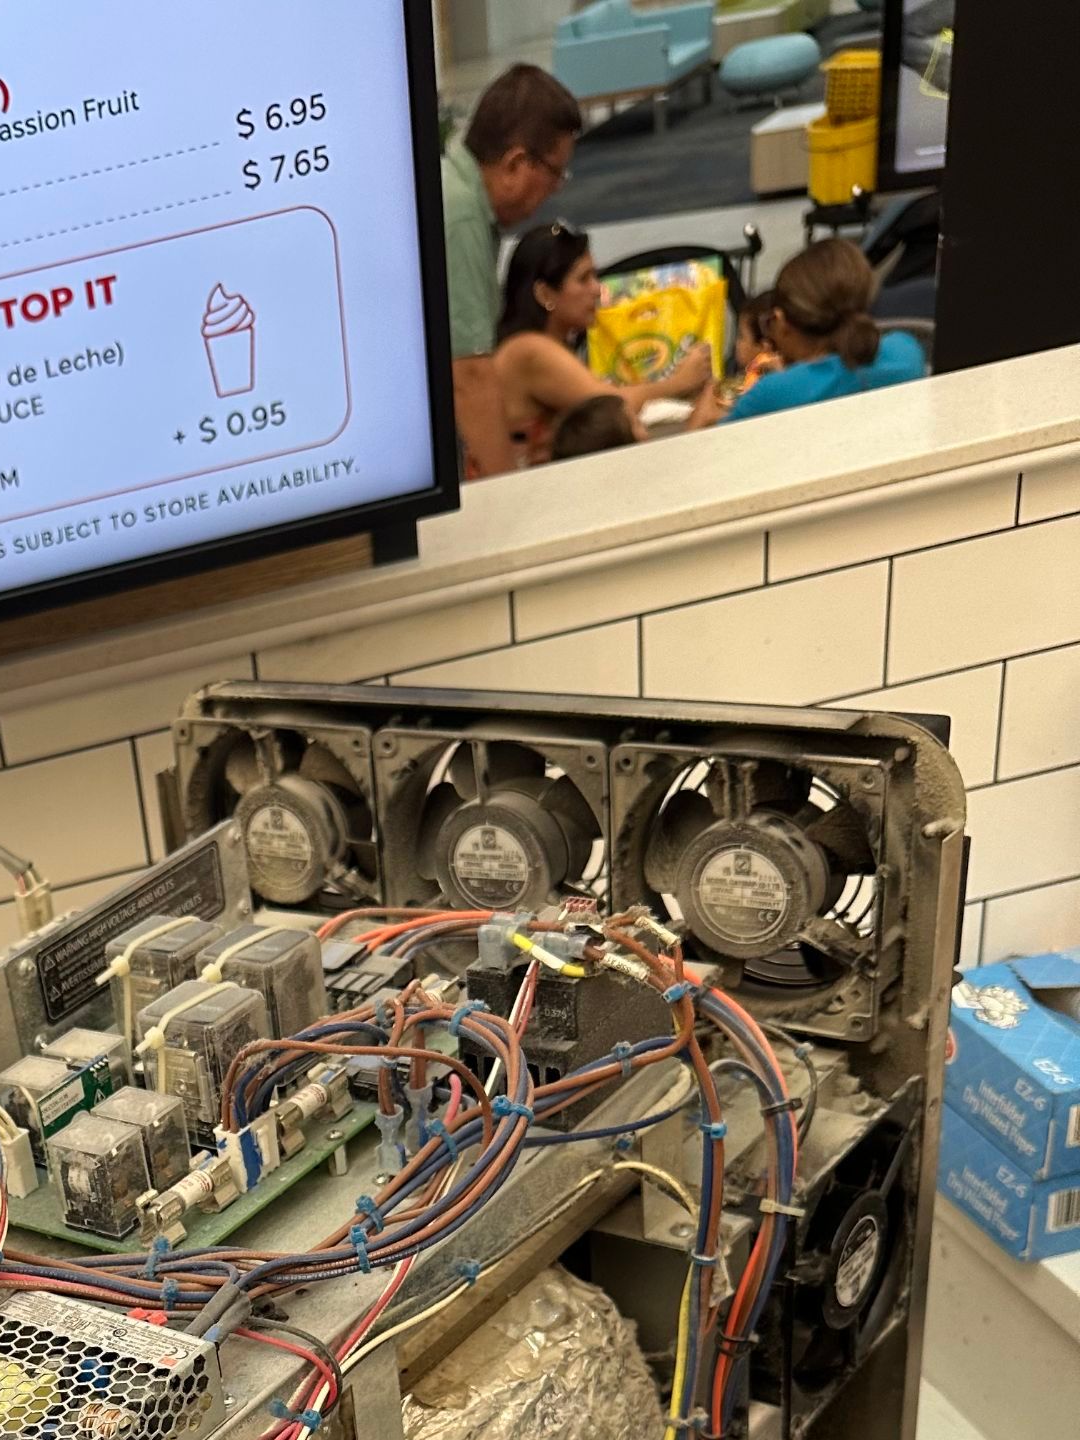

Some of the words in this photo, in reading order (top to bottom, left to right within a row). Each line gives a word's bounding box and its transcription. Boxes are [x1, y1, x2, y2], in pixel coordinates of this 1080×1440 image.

[83, 90, 140, 124] Fruit
[265, 93, 326, 132] 6.95
[270, 145, 329, 183] 7.65
[85, 275, 117, 310] IT
[7, 362, 37, 387] de
[44, 342, 125, 380] Leche)
[226, 401, 286, 437] 0.95
[13, 519, 101, 555] SUBJECT
[110, 511, 137, 532] TO
[143, 492, 210, 524] STORE
[217, 457, 360, 507] AVAILABILITY.
[106, 904, 139, 931] VOLTAGE
[152, 880, 175, 901] VOLTS
